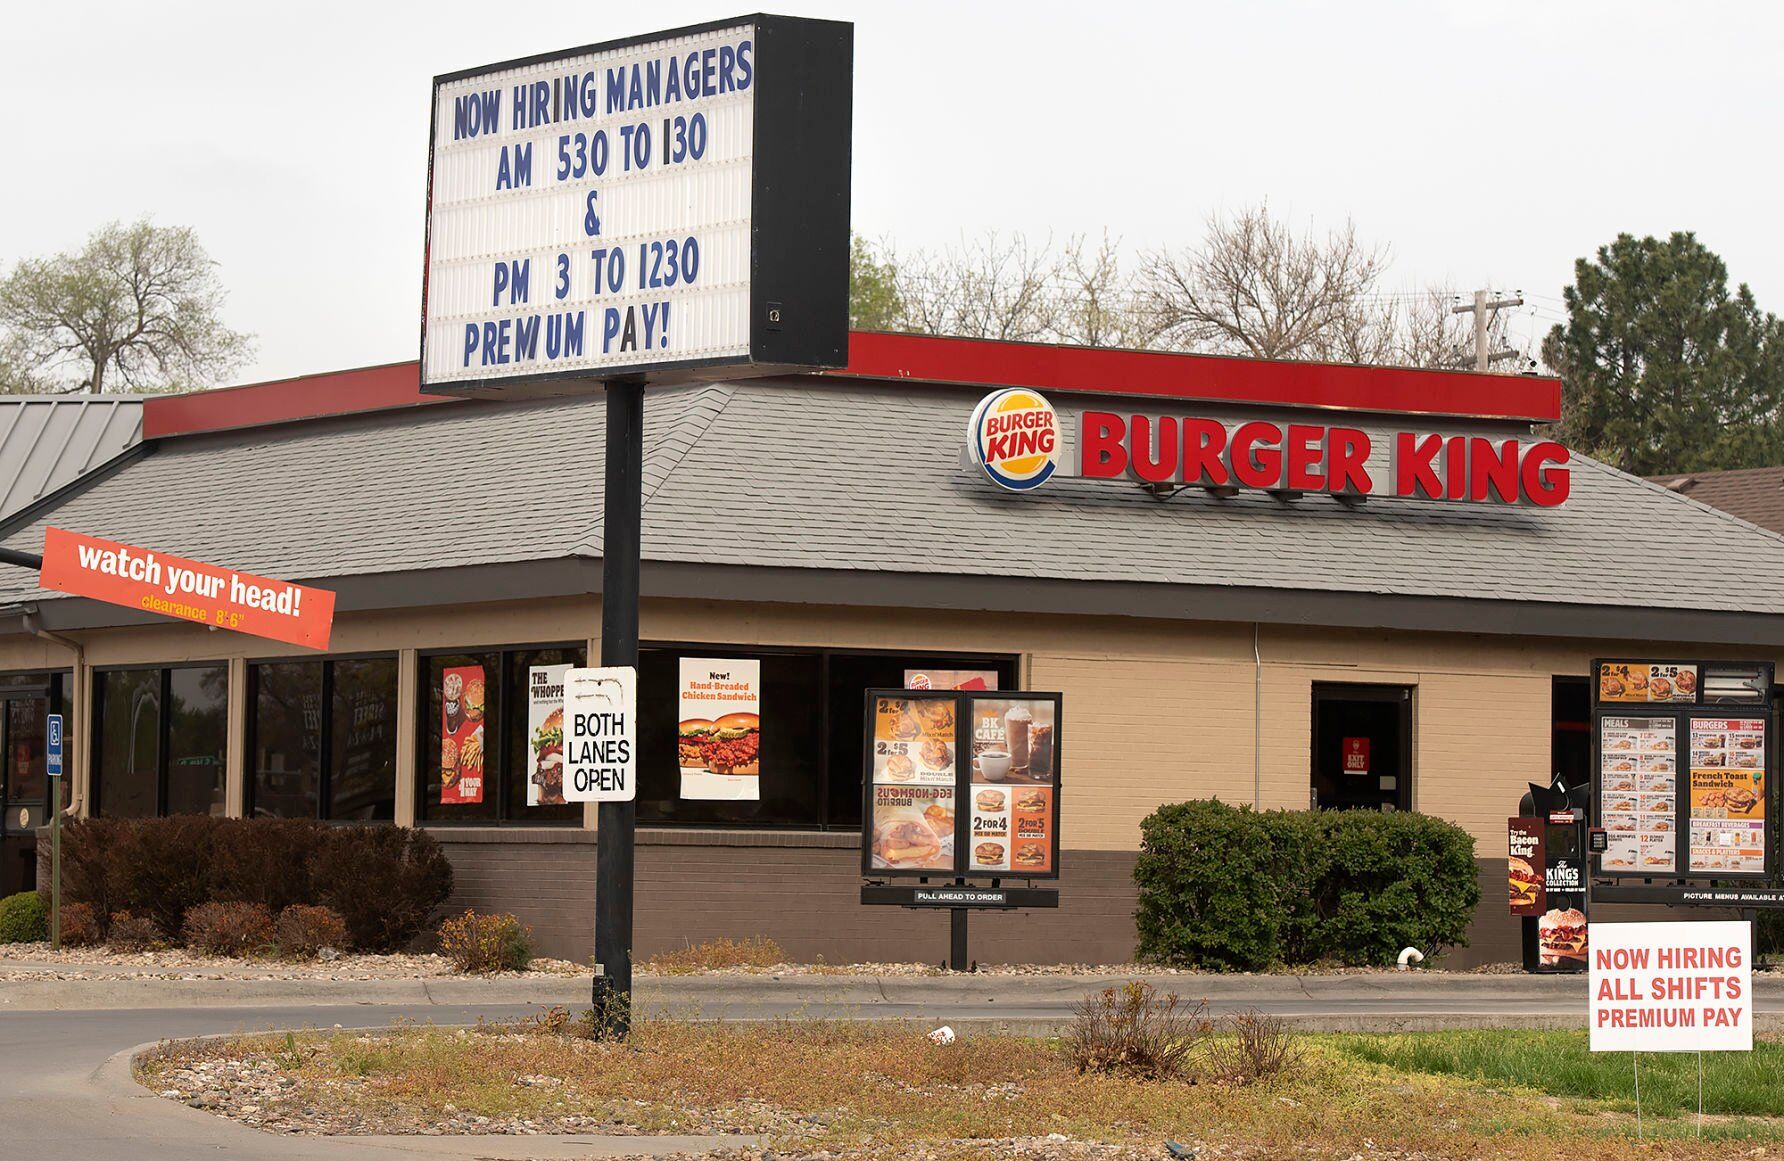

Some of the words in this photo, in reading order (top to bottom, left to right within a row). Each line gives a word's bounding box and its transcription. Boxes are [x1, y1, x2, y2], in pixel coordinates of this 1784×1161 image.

[454, 89, 501, 140] NOW
[512, 71, 597, 131] HIRING
[607, 40, 752, 114] MANAGERS
[496, 142, 532, 190] AM
[557, 130, 608, 181] 530
[620, 122, 651, 171] TO
[663, 112, 707, 165] 130
[584, 190, 600, 236] &
[493, 259, 530, 307] PM
[555, 253, 570, 300] 3
[592, 246, 625, 295] TO
[639, 236, 699, 290] 1230
[463, 311, 585, 368] PREMIUM
[602, 301, 671, 354] PAY!
[986, 410, 1054, 439] BURGER
[984, 428, 1056, 466] KING
[1080, 410, 1374, 496] BURGER
[1394, 431, 1571, 507] KING
[78, 544, 162, 585] watch
[164, 565, 226, 599] your
[230, 573, 302, 617] head!
[141, 594, 207, 621] clearance
[709, 672, 730, 680] New!
[1602, 665, 1610, 676] 2
[1616, 665, 1629, 675] $4
[1651, 666, 1659, 677] 2
[1665, 666, 1678, 678] $5
[532, 672, 547, 685] THE
[690, 681, 749, 691] Hand-Breaded
[682, 691, 716, 701] Chicken
[717, 692, 757, 702] Sandwich
[878, 700, 888, 714] 2
[575, 713, 625, 737] BOTH
[982, 717, 999, 728] BK
[1604, 719, 1629, 728] MEALS
[1692, 721, 1728, 730] BURGERS
[975, 727, 1005, 740] CAFÉ
[569, 740, 630, 764] LANES
[877, 741, 887, 755] 2
[894, 742, 908, 756] $5
[574, 768, 625, 792] OPEN
[1692, 772, 1723, 780] French
[1724, 772, 1748, 780] Toast
[1692, 780, 1734, 788] Sandwich
[974, 816, 982, 830] 2
[983, 820, 998, 829] FOR
[1018, 817, 1025, 829] 2
[1025, 820, 1037, 828] FOR
[1510, 836, 1539, 845] Bacon
[1510, 845, 1535, 858] King
[1596, 948, 1650, 970] NOW
[1657, 946, 1742, 970] HIRING
[1597, 978, 1643, 1001] ALL
[1651, 976, 1742, 1000] SHIFTS
[1597, 1008, 1695, 1028] PREMIUM
[1703, 1007, 1743, 1028] PAY
